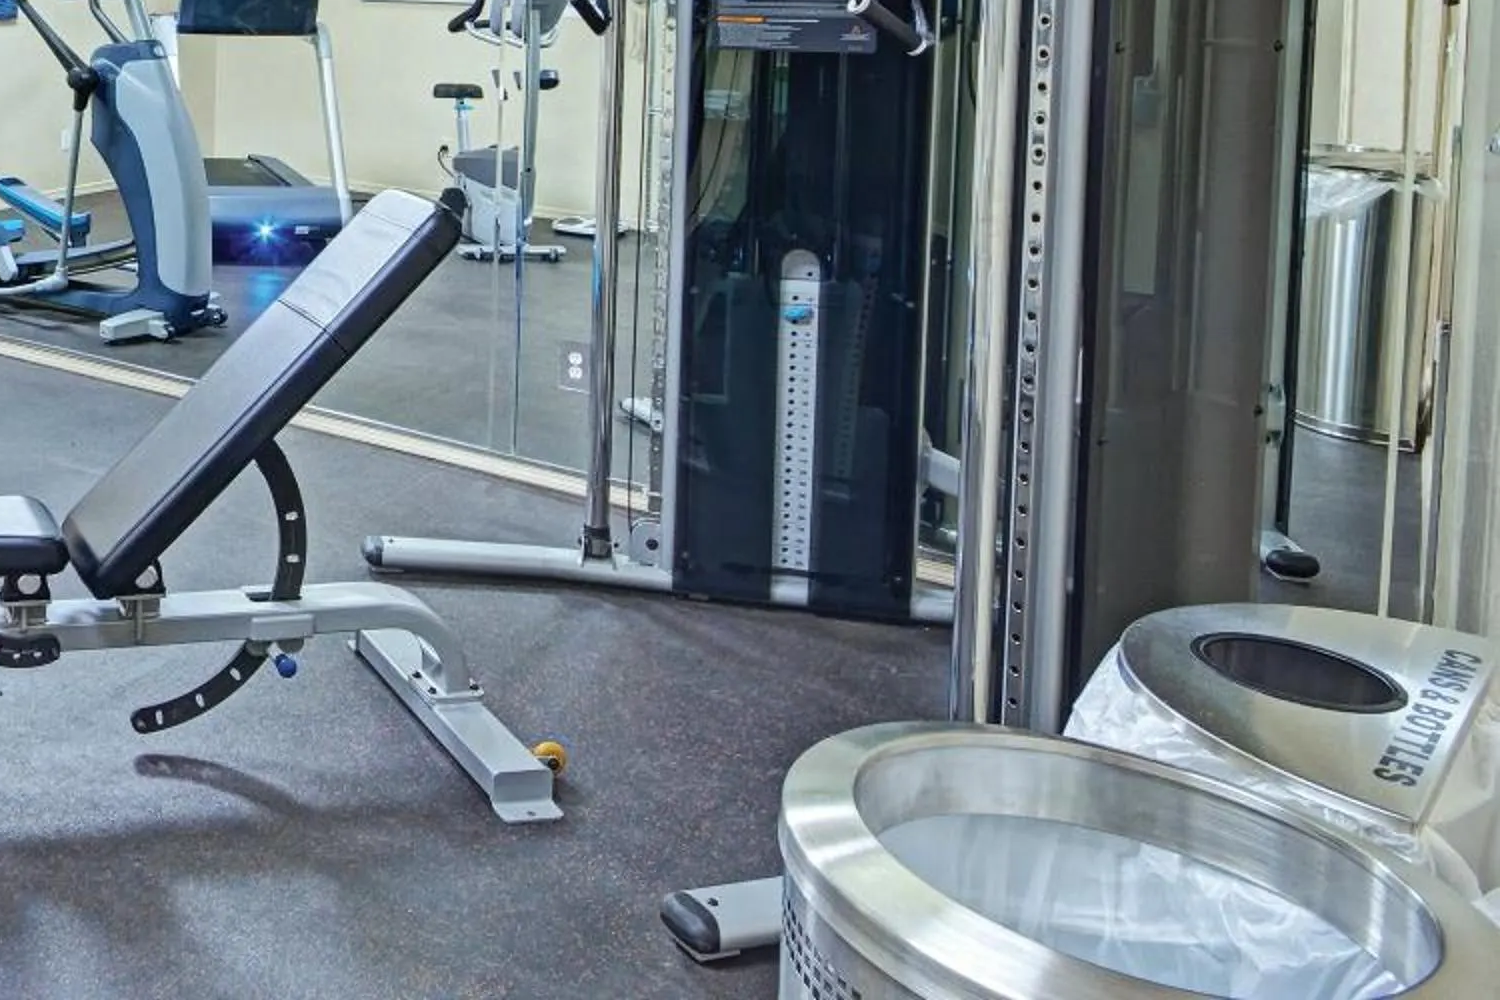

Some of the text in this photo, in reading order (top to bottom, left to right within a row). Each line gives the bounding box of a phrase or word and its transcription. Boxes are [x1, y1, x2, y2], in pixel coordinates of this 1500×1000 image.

[1373, 649, 1482, 787] CANS & BOTTLES
